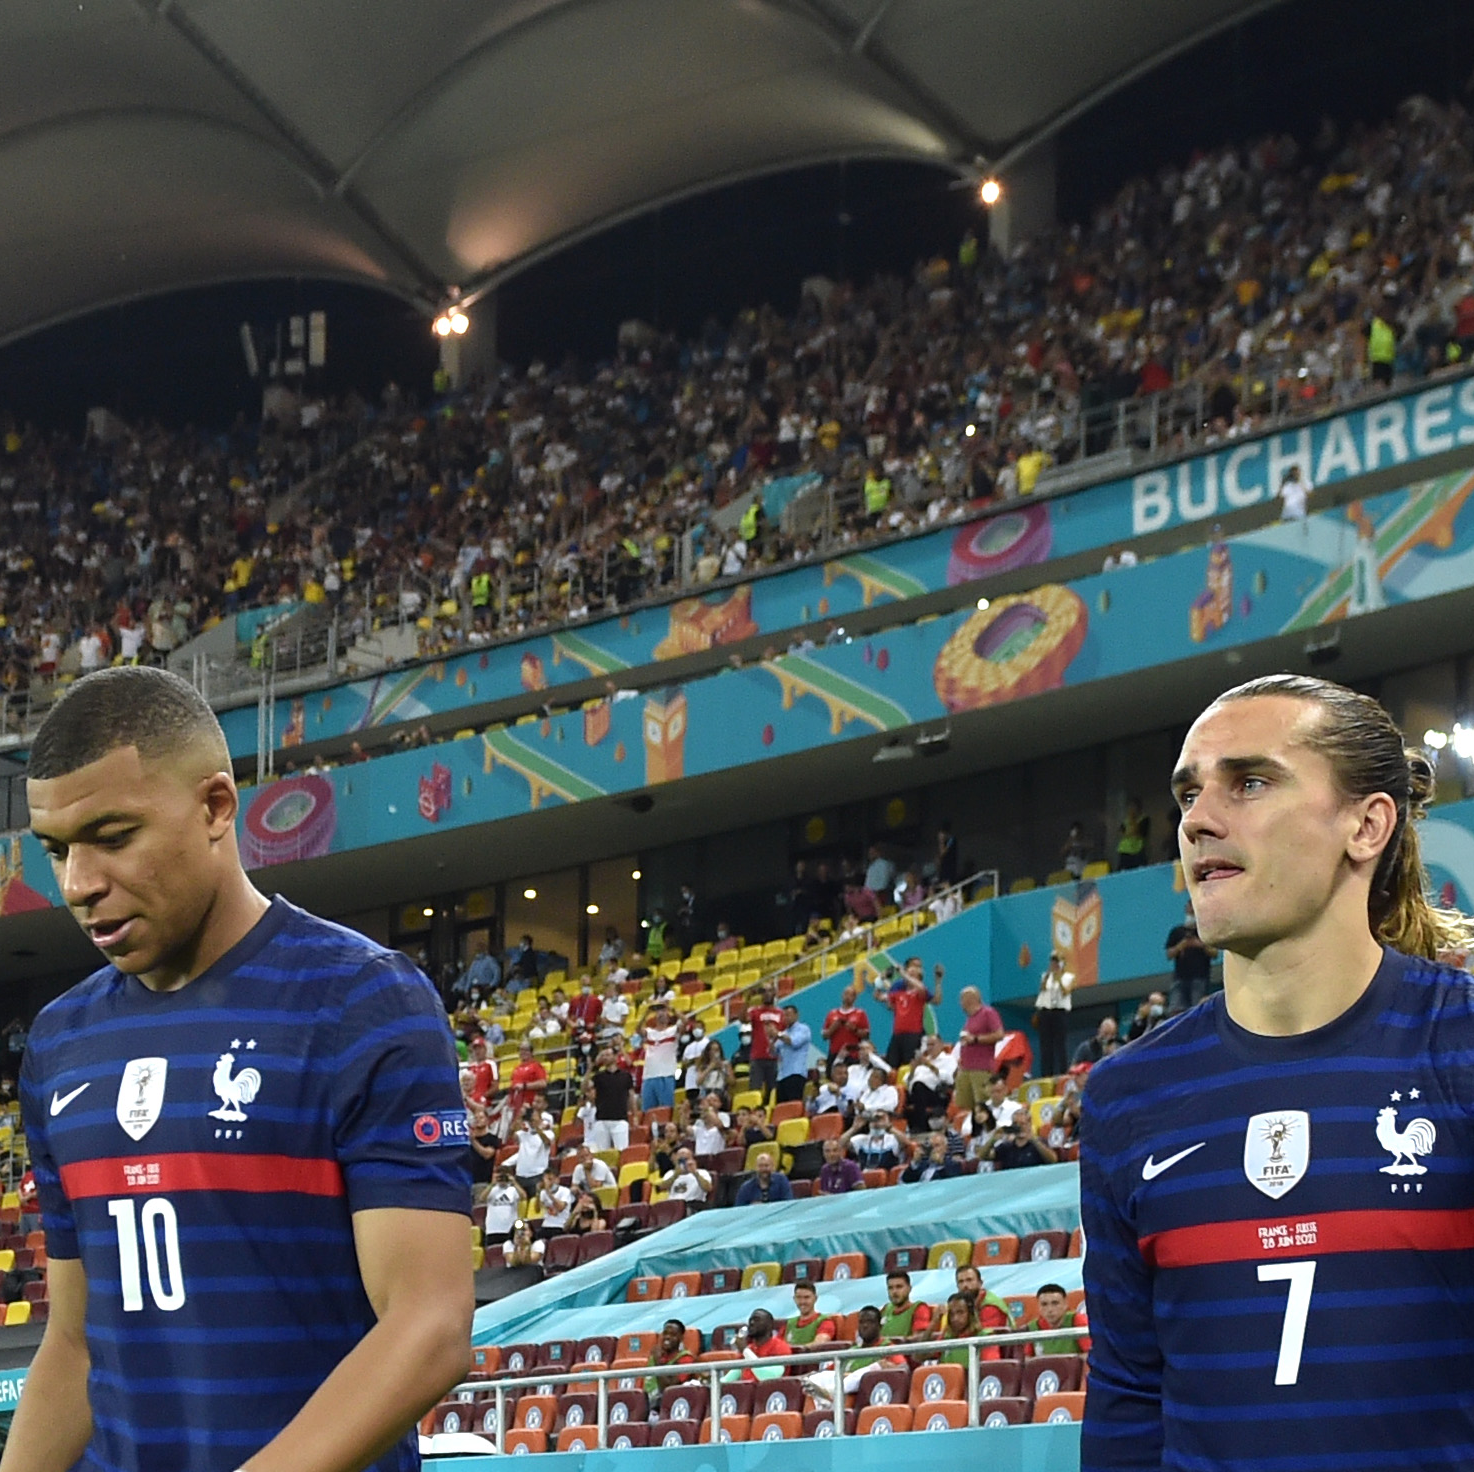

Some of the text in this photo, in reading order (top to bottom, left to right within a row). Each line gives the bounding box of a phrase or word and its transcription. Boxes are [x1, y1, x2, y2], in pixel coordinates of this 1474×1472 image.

[1263, 1165, 1290, 1176] FIFA
[108, 1197, 186, 1312] 10
[1258, 1224, 1288, 1239] FRANCE
[1257, 1260, 1317, 1386] 7
